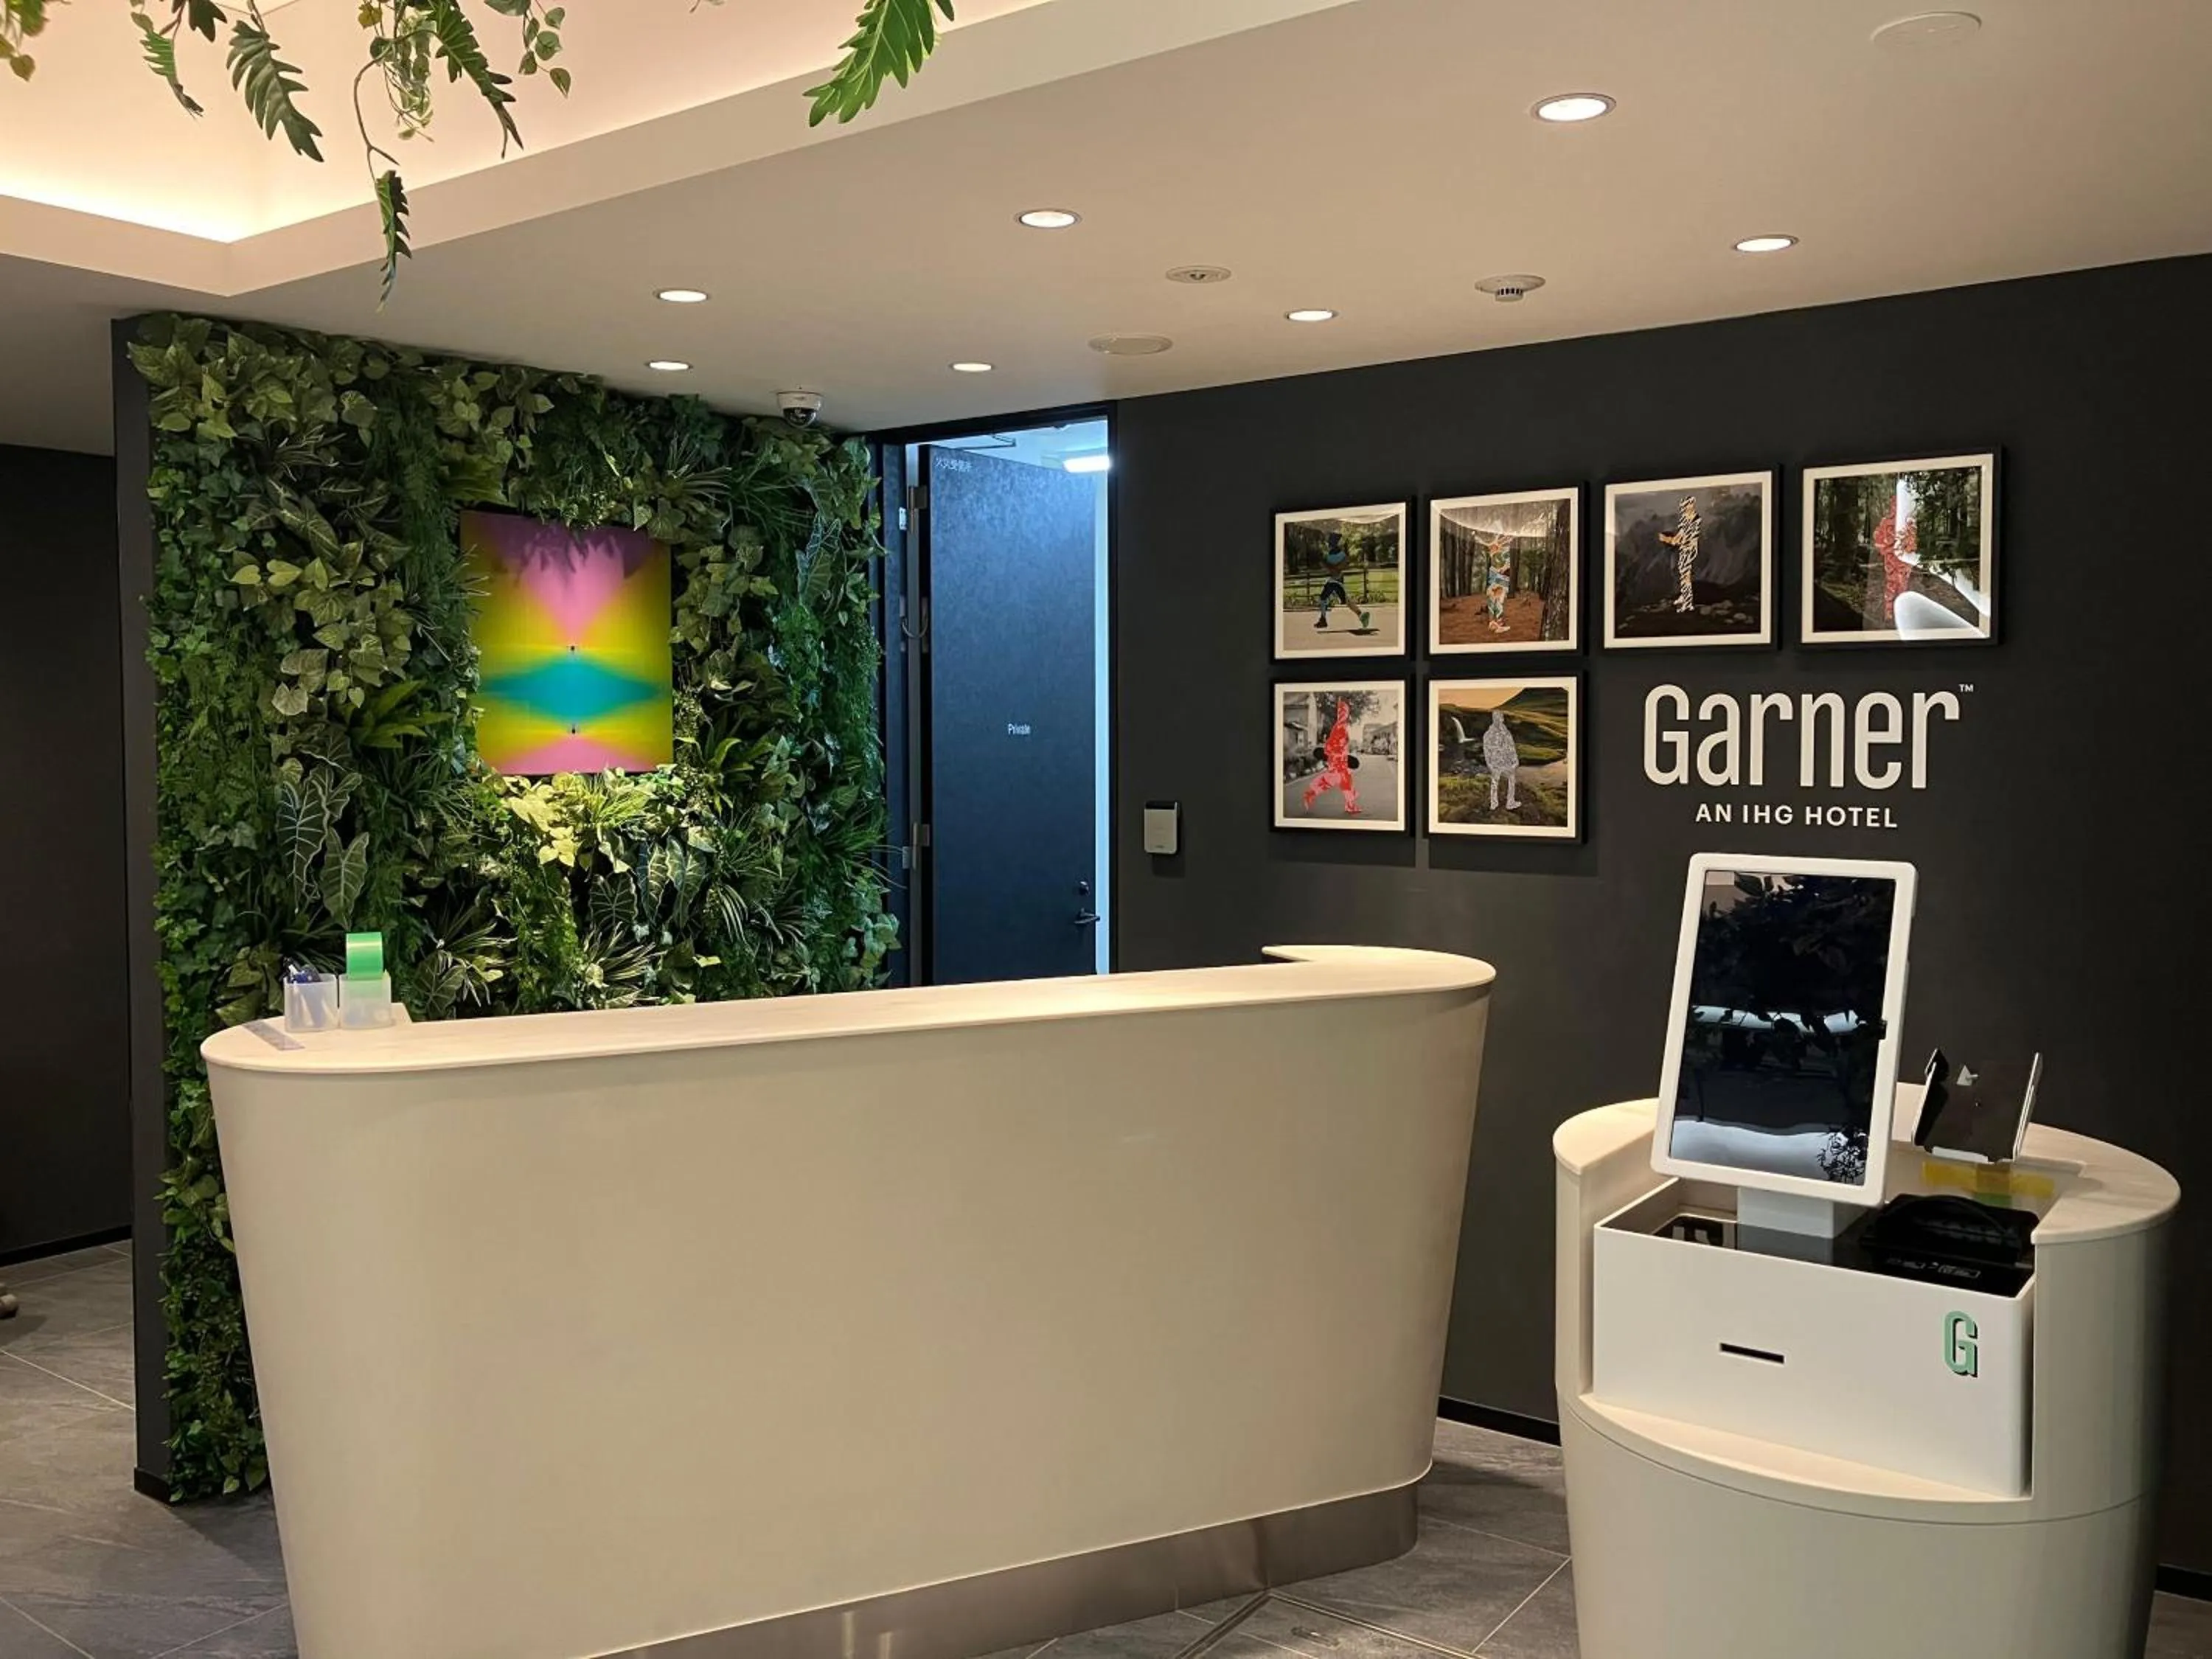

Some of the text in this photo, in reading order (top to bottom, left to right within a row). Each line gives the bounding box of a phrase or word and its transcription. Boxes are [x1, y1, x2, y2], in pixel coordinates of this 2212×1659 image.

[1644, 684, 1960, 790] Garner
[1695, 803, 1898, 828] AN IHG HOTEL
[1944, 1310, 1978, 1377] G
